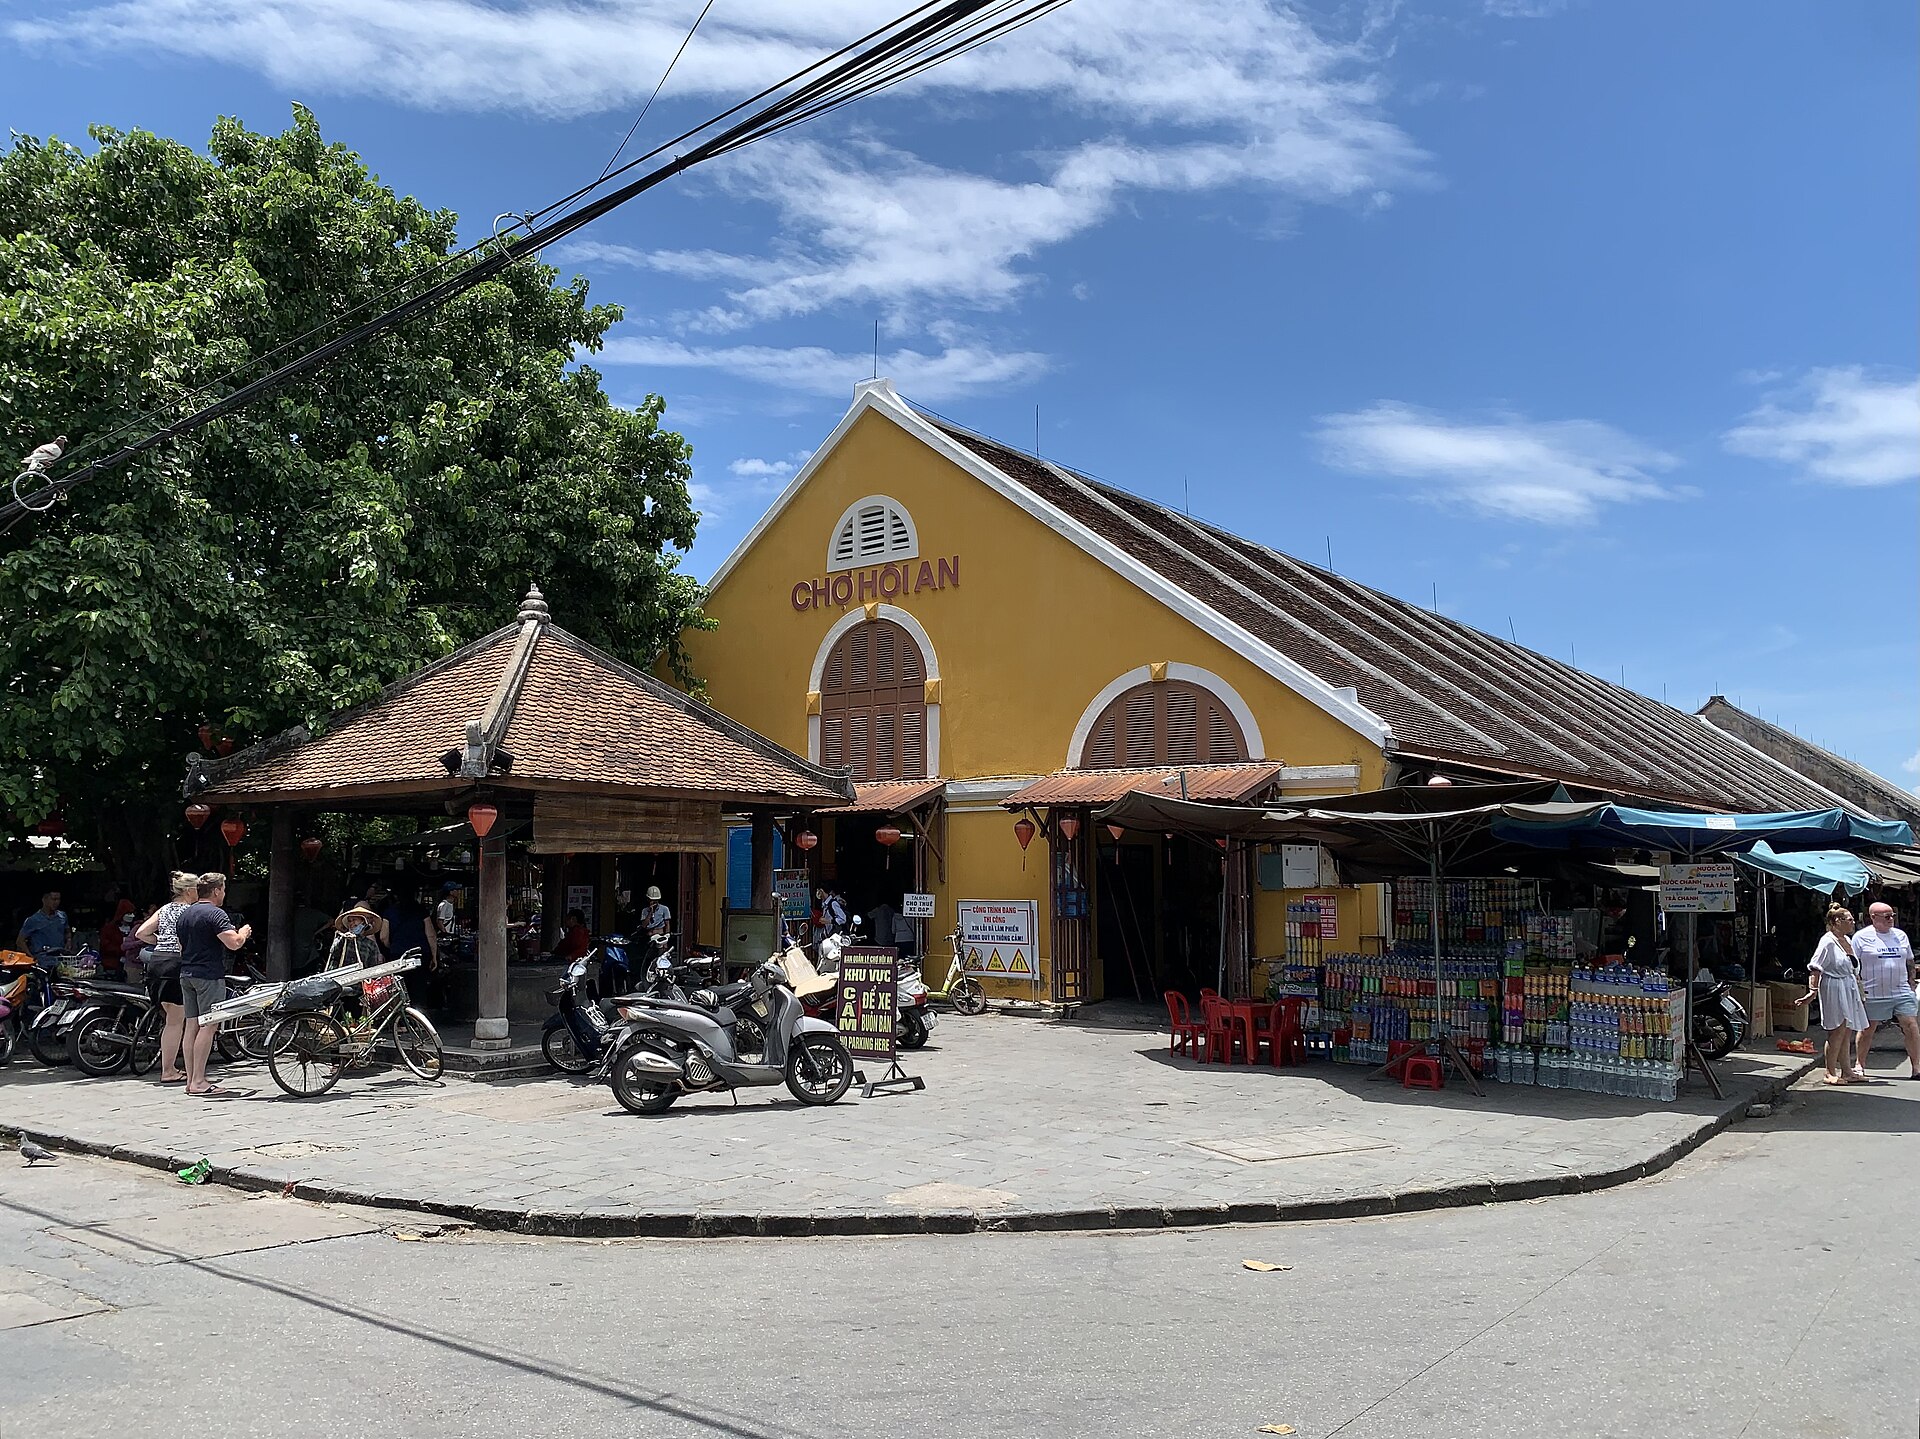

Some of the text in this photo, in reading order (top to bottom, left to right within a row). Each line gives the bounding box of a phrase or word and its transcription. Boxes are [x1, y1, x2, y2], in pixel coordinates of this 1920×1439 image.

[791, 555, 960, 611] CHỢ HỘI AN
[973, 905, 986, 913] CÔNG
[987, 905, 1002, 914] TRÌNH
[992, 915, 1006, 923] CÔNG
[844, 968, 891, 985] KHU VỰC
[862, 985, 892, 1010] ĐỂ XE
[839, 987, 858, 1031] CẤM
[861, 1010, 892, 1033] BUÔN BÁN
[848, 1036, 874, 1050] PARKING
[874, 1037, 890, 1051] HERE
